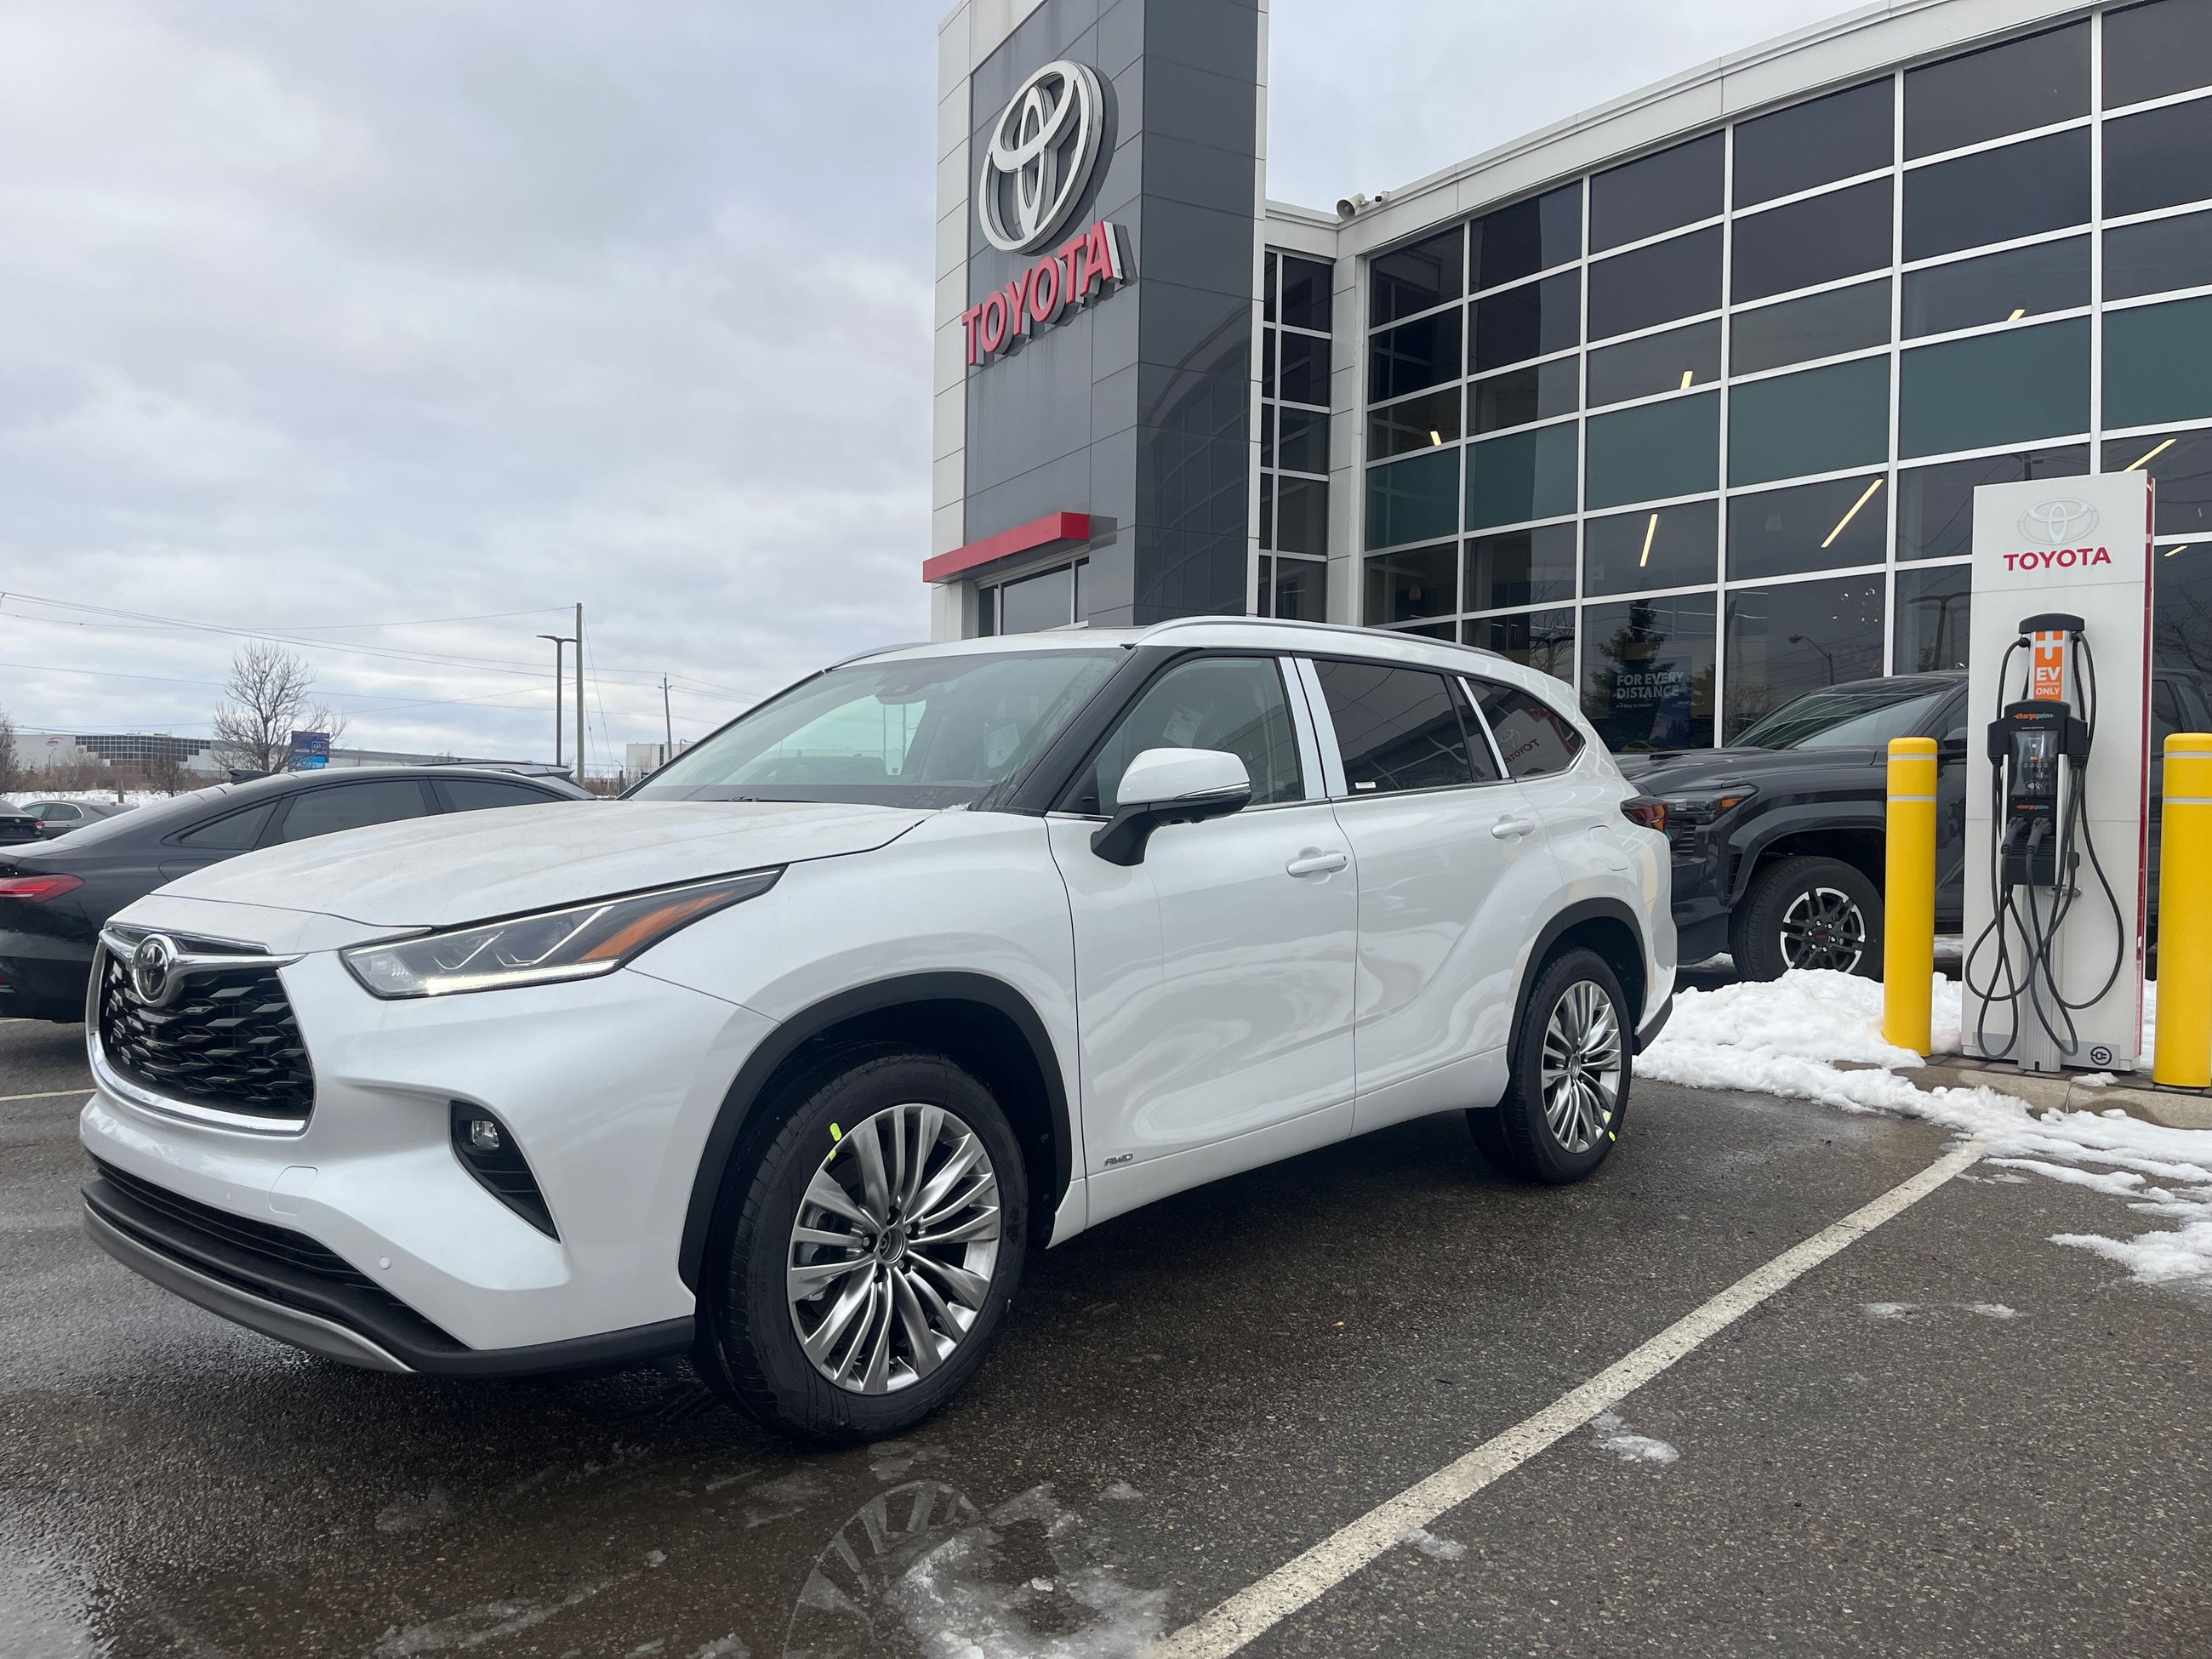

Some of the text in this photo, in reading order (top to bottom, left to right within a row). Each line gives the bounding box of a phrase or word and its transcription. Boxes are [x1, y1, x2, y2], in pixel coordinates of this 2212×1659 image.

[961, 219, 1120, 366] TOYOTA
[2003, 546, 2112, 571] TOYOTA
[1617, 671, 1685, 687] FOR EVERY
[2036, 666, 2061, 681] EV
[1616, 685, 1679, 699] DISTANCE
[2035, 687, 2061, 696] ONLY
